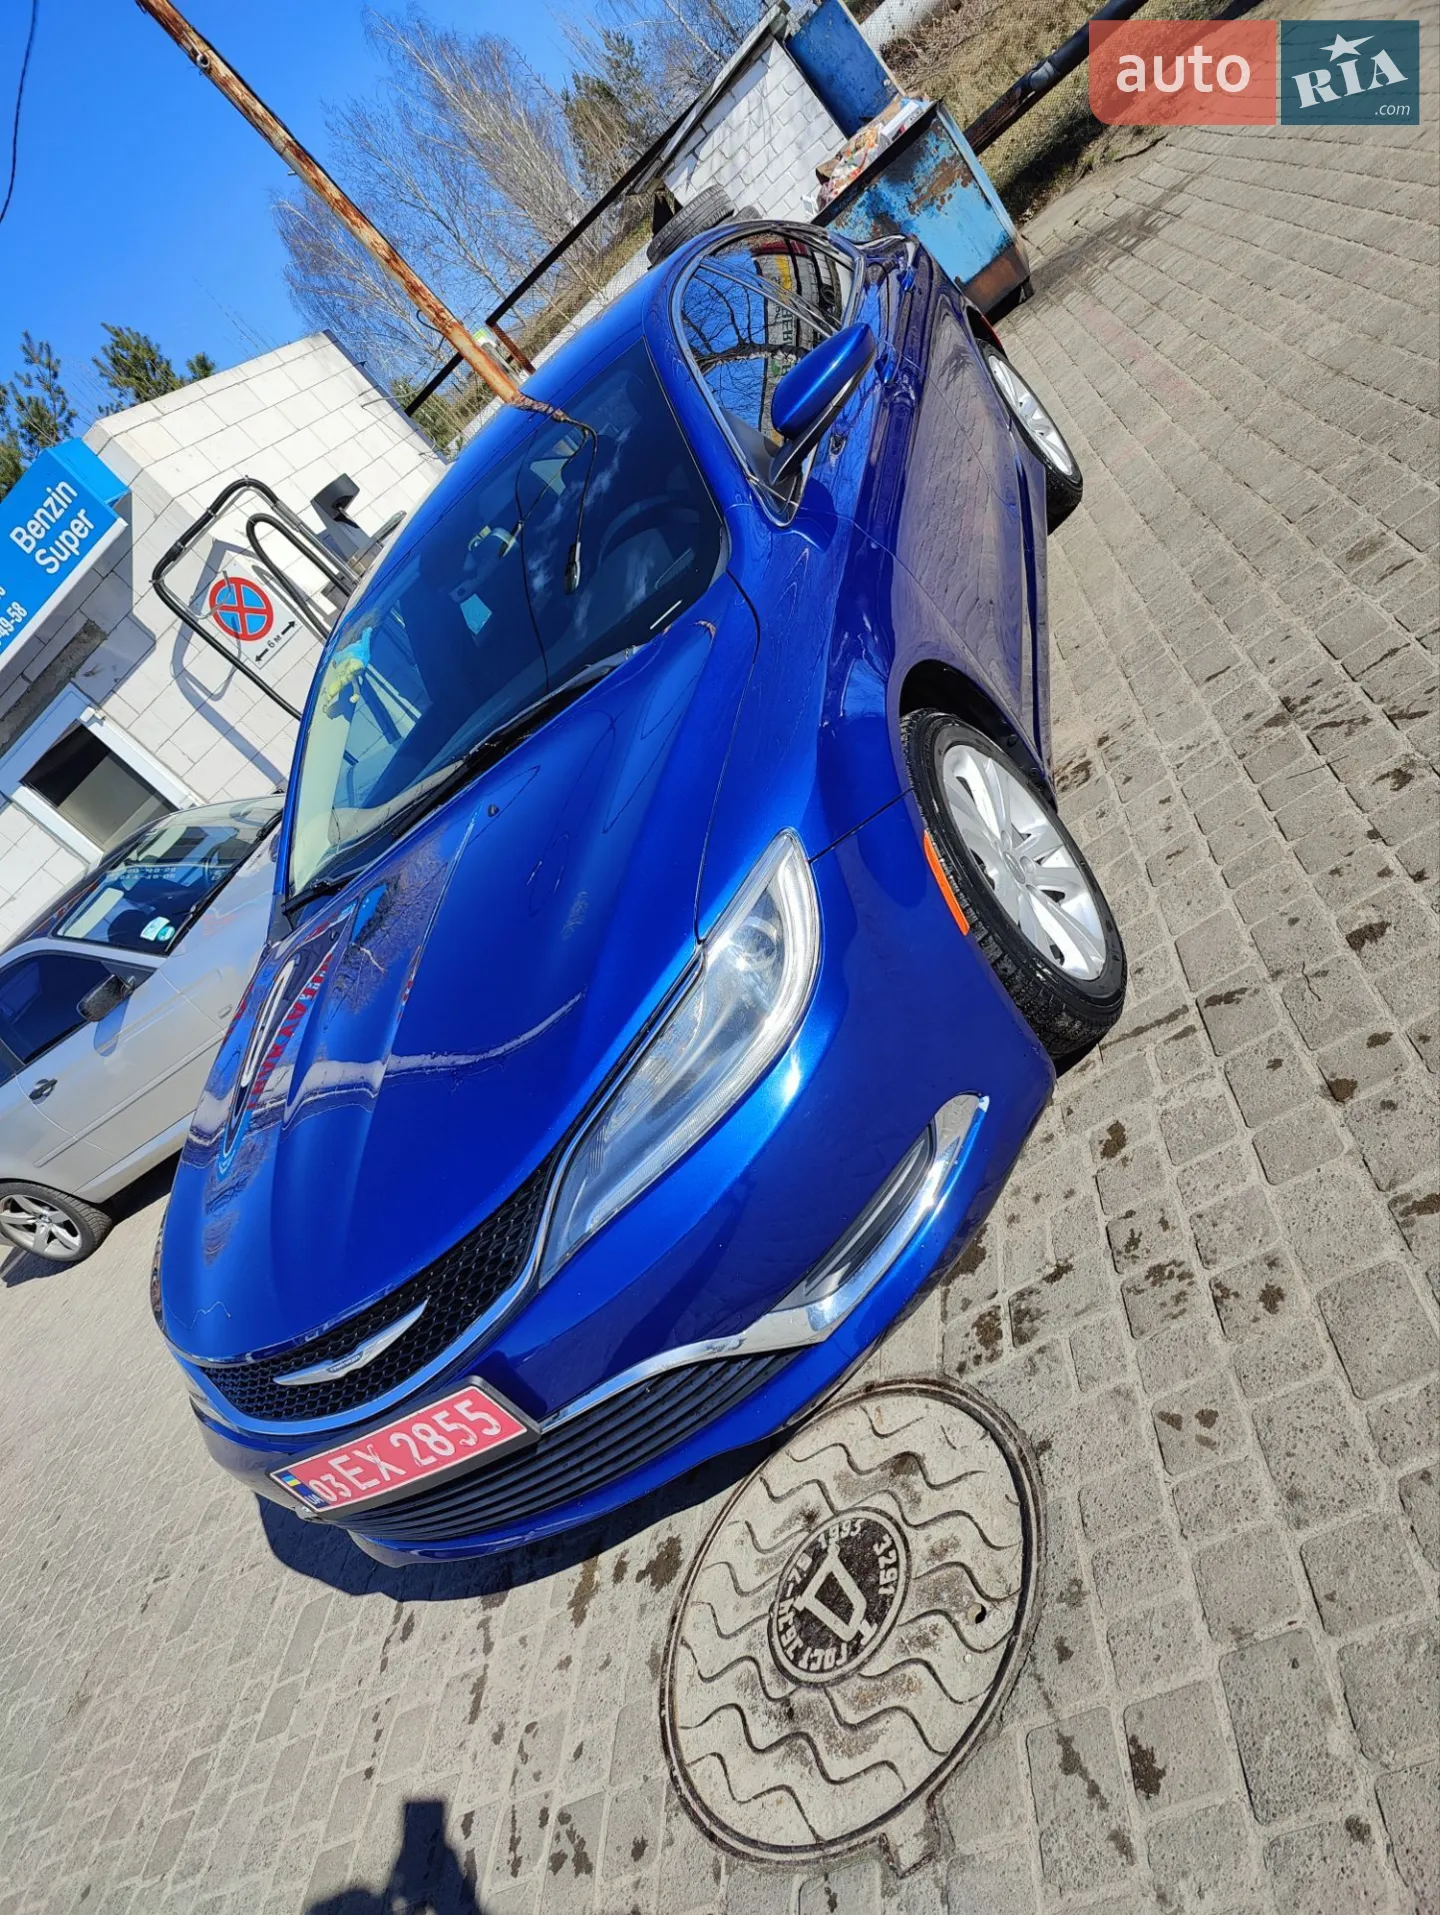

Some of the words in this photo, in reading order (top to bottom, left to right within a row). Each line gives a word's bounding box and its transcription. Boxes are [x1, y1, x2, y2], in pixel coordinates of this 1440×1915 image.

[9, 480, 78, 554] Benzin
[35, 508, 95, 574] Super
[267, 640, 275, 648] 6
[389, 1399, 502, 1467] 2855
[873, 1533, 898, 1596] 3291
